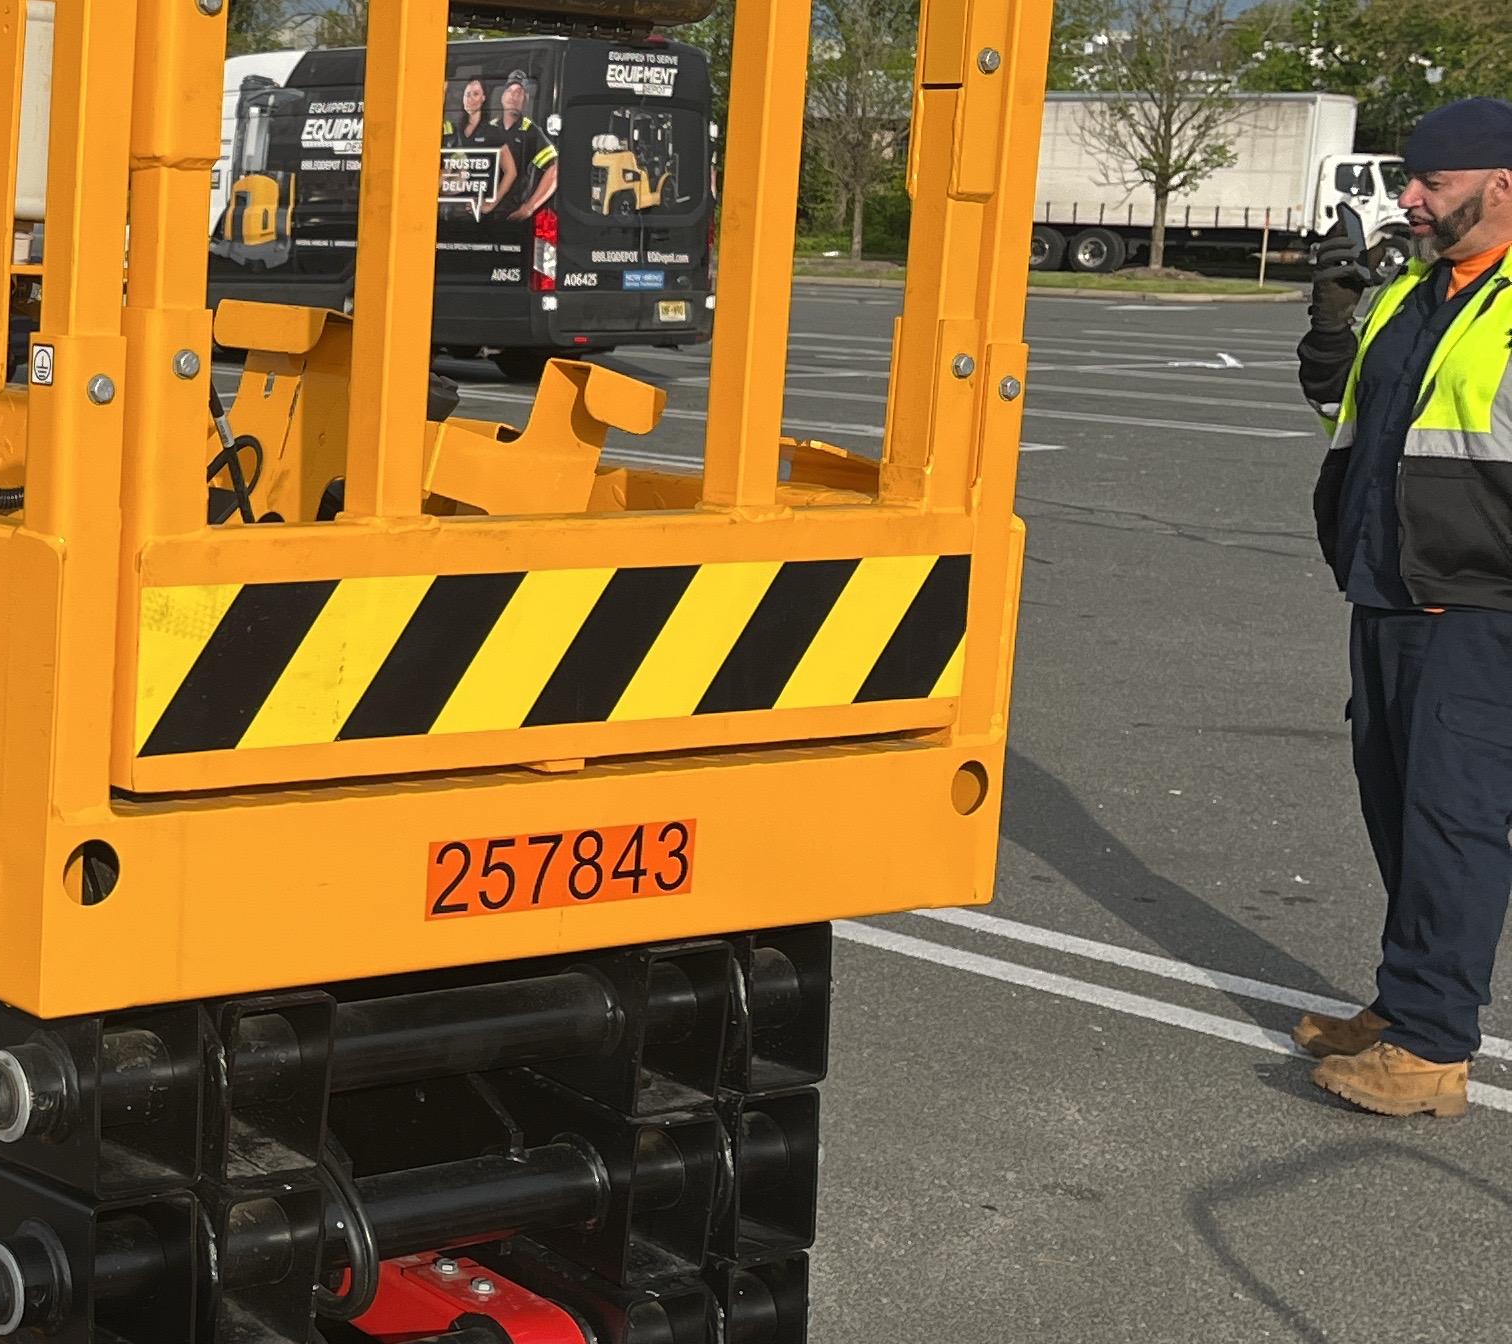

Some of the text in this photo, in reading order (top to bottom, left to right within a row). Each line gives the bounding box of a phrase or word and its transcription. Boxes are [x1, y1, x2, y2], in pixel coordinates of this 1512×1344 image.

[606, 64, 678, 85] EQUIPMENT
[443, 159, 489, 170] TRUSTED
[442, 181, 487, 192] DELIVER
[564, 273, 598, 287] A06425
[430, 820, 690, 916] 257843
